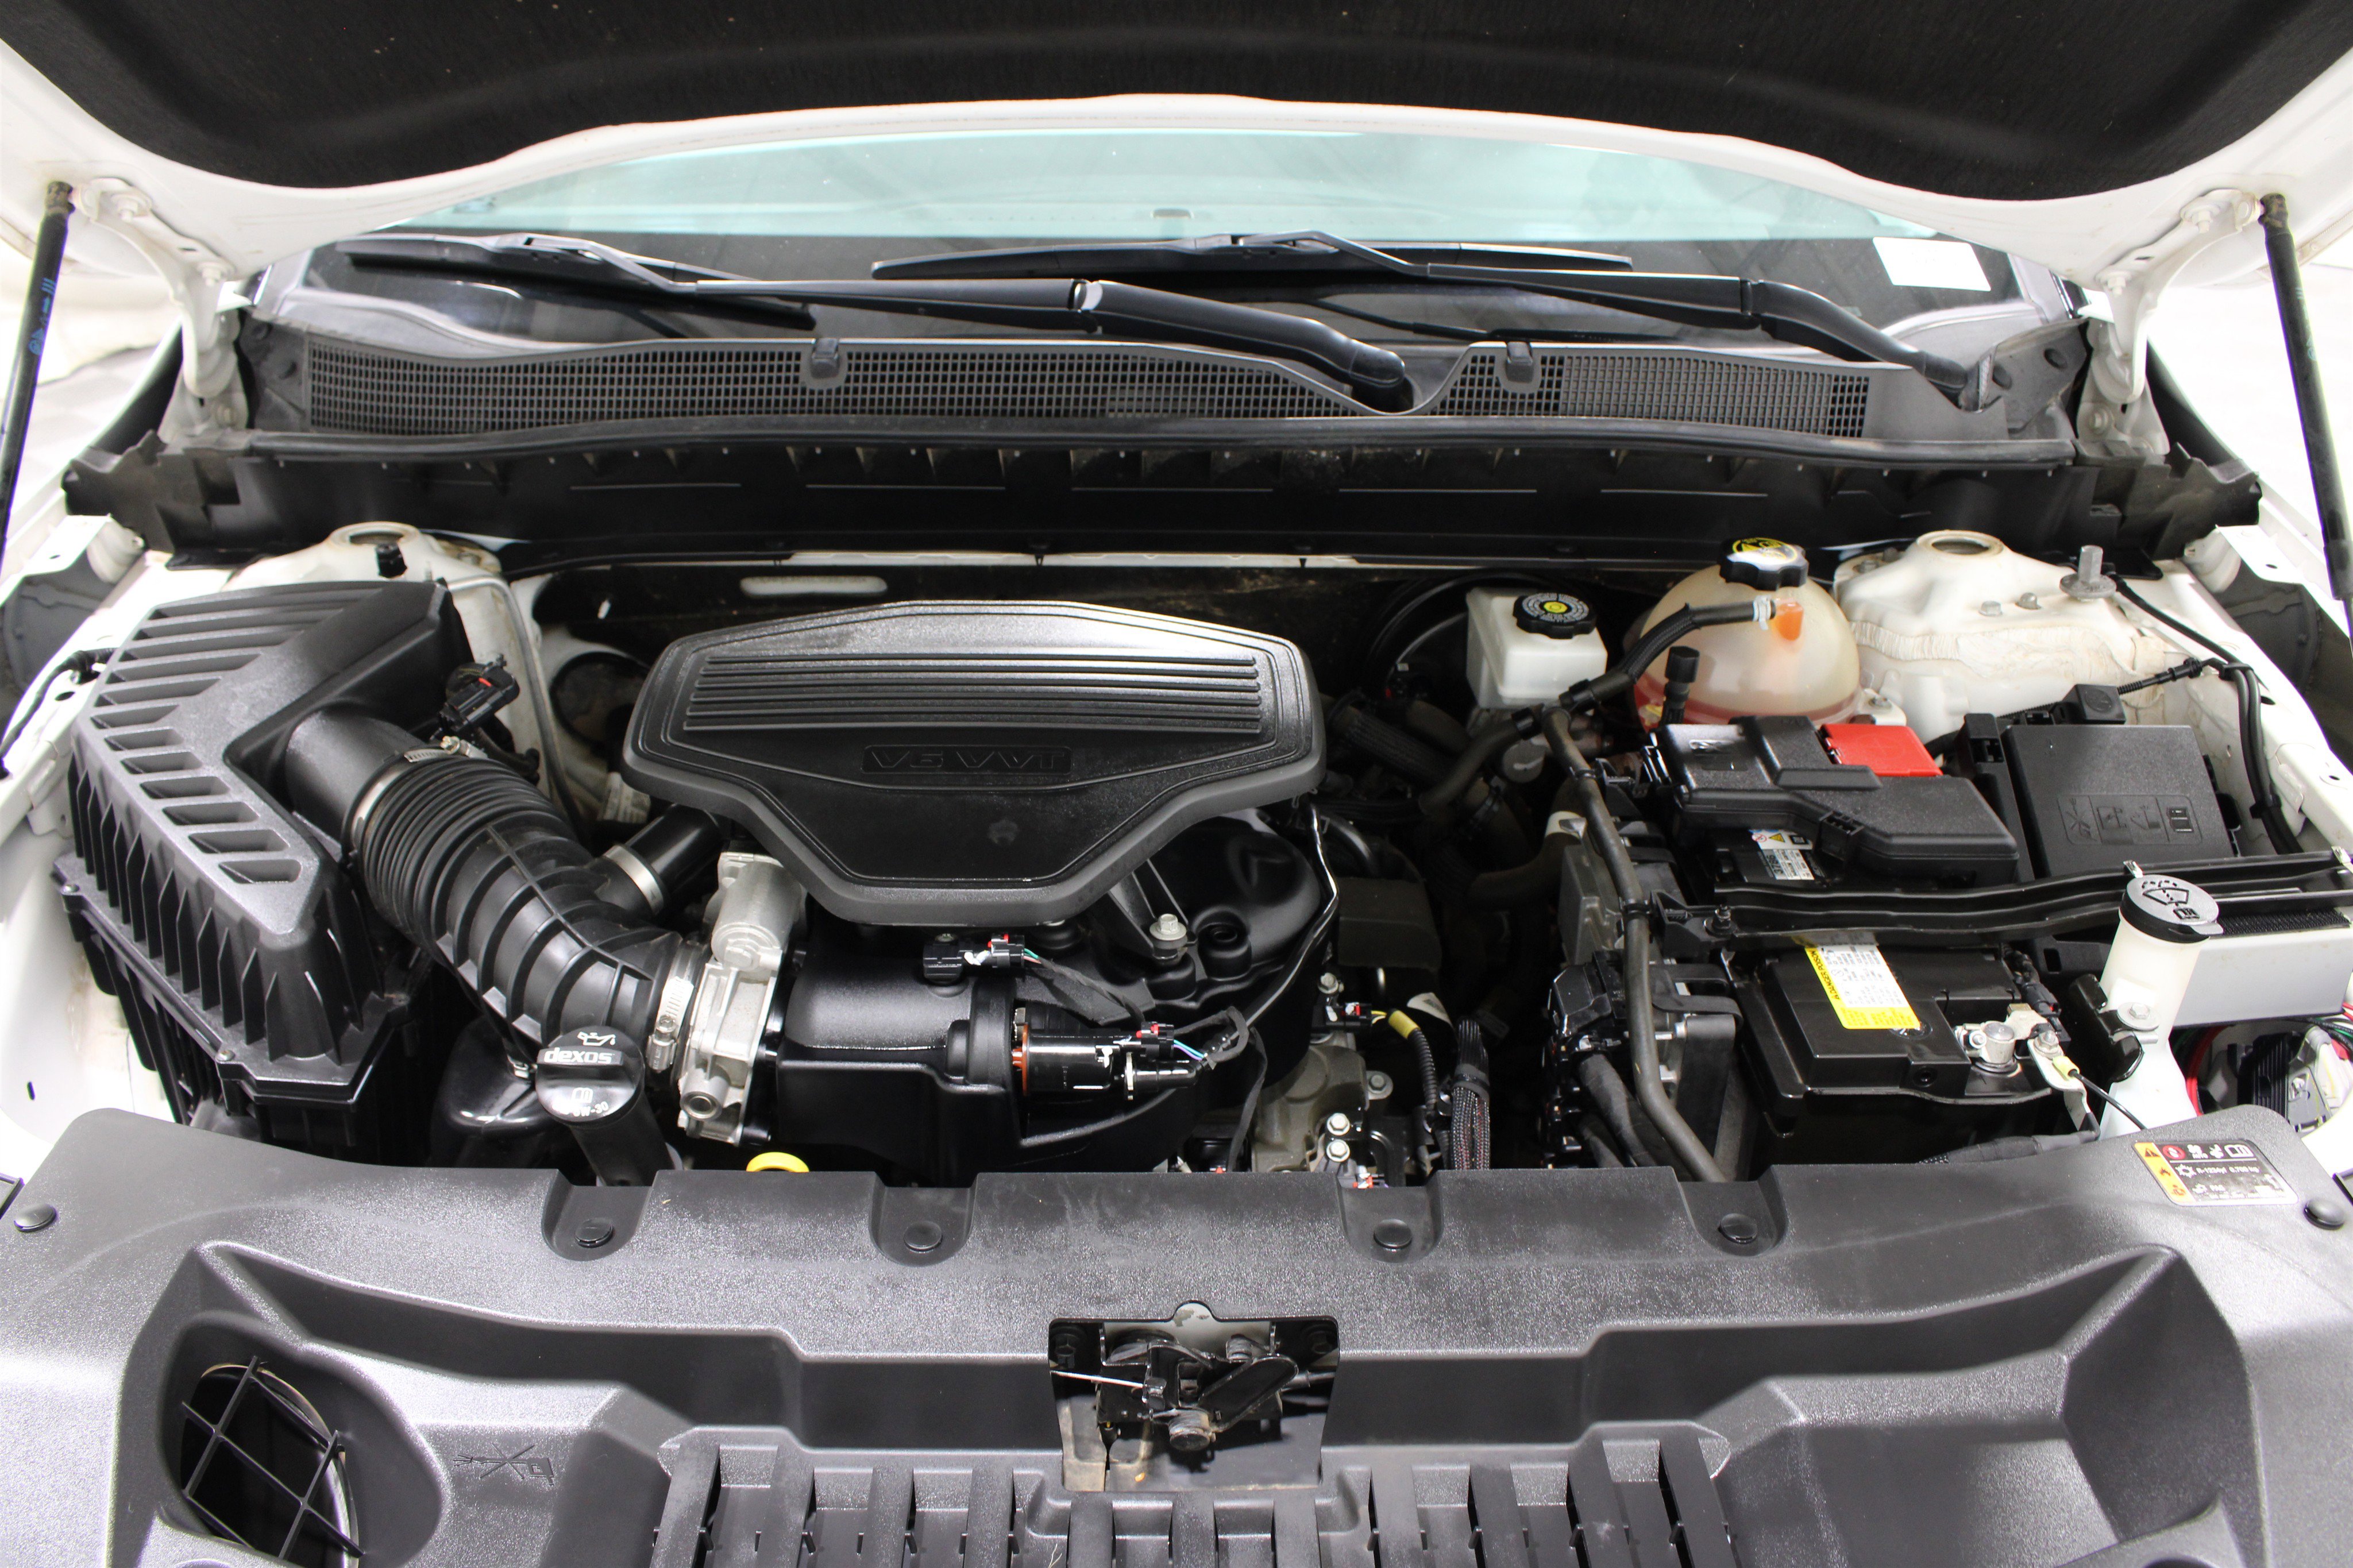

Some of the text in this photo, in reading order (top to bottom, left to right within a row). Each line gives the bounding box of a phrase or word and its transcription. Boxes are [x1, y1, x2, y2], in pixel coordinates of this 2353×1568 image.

[871, 750, 1066, 770] V6 VVT
[543, 1046, 612, 1064] dexos
